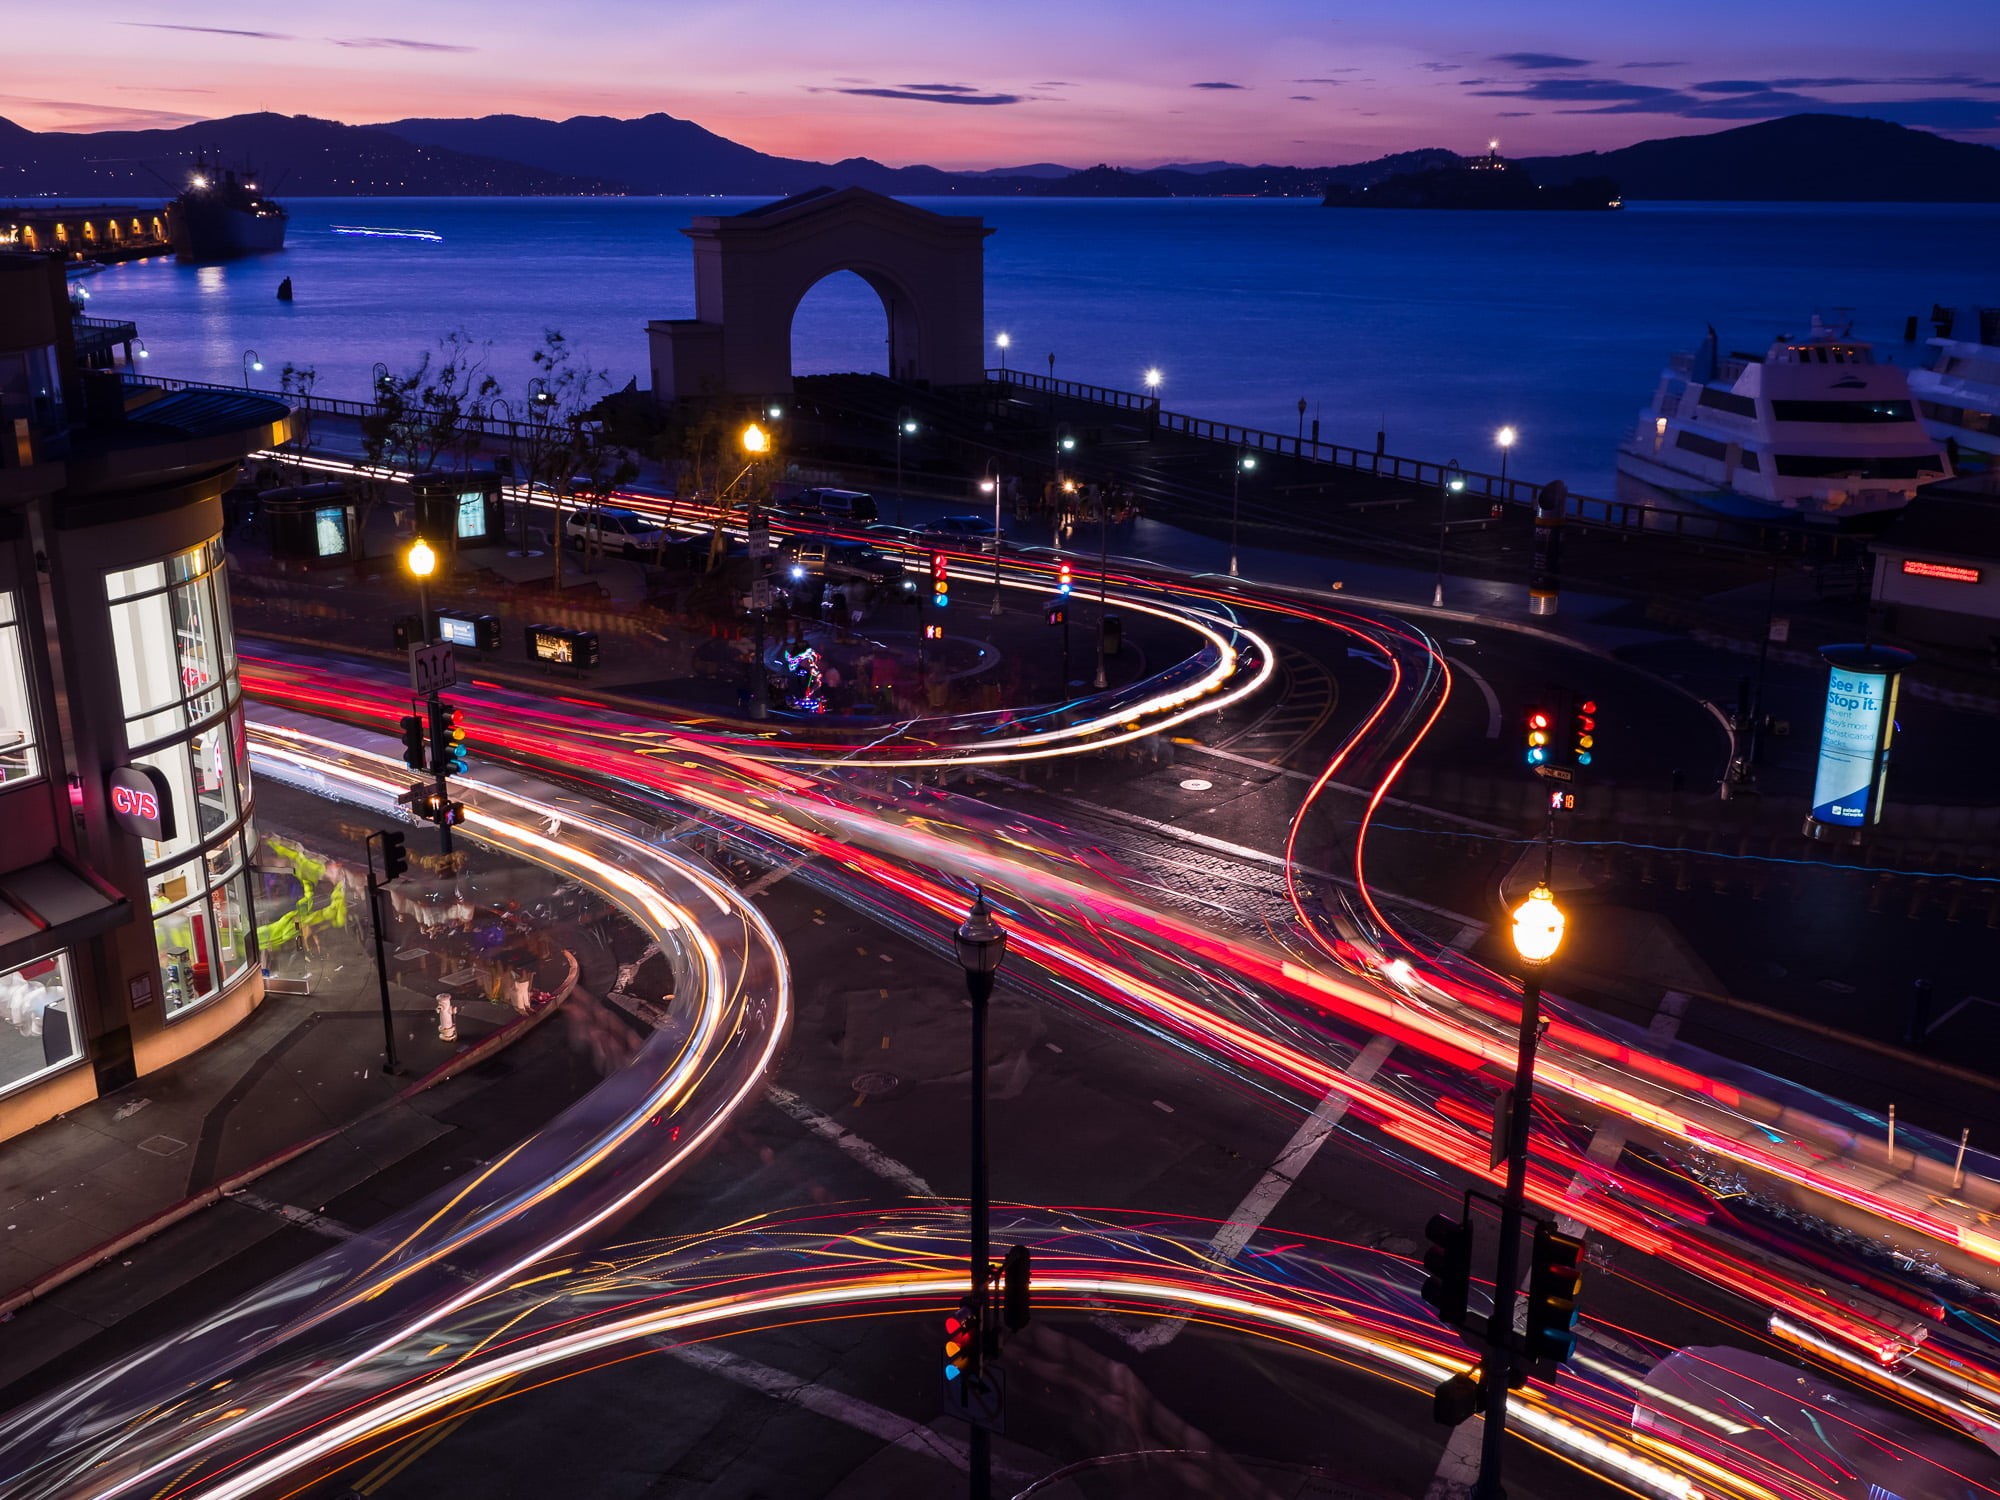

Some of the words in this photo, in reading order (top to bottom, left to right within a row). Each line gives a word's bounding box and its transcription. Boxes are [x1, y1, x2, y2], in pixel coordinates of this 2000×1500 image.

[1830, 675, 1854, 693] See
[1858, 681, 1872, 695] it.
[1828, 691, 1860, 711] Stop
[1863, 698, 1878, 711] it.
[112, 786, 158, 820] CVS
